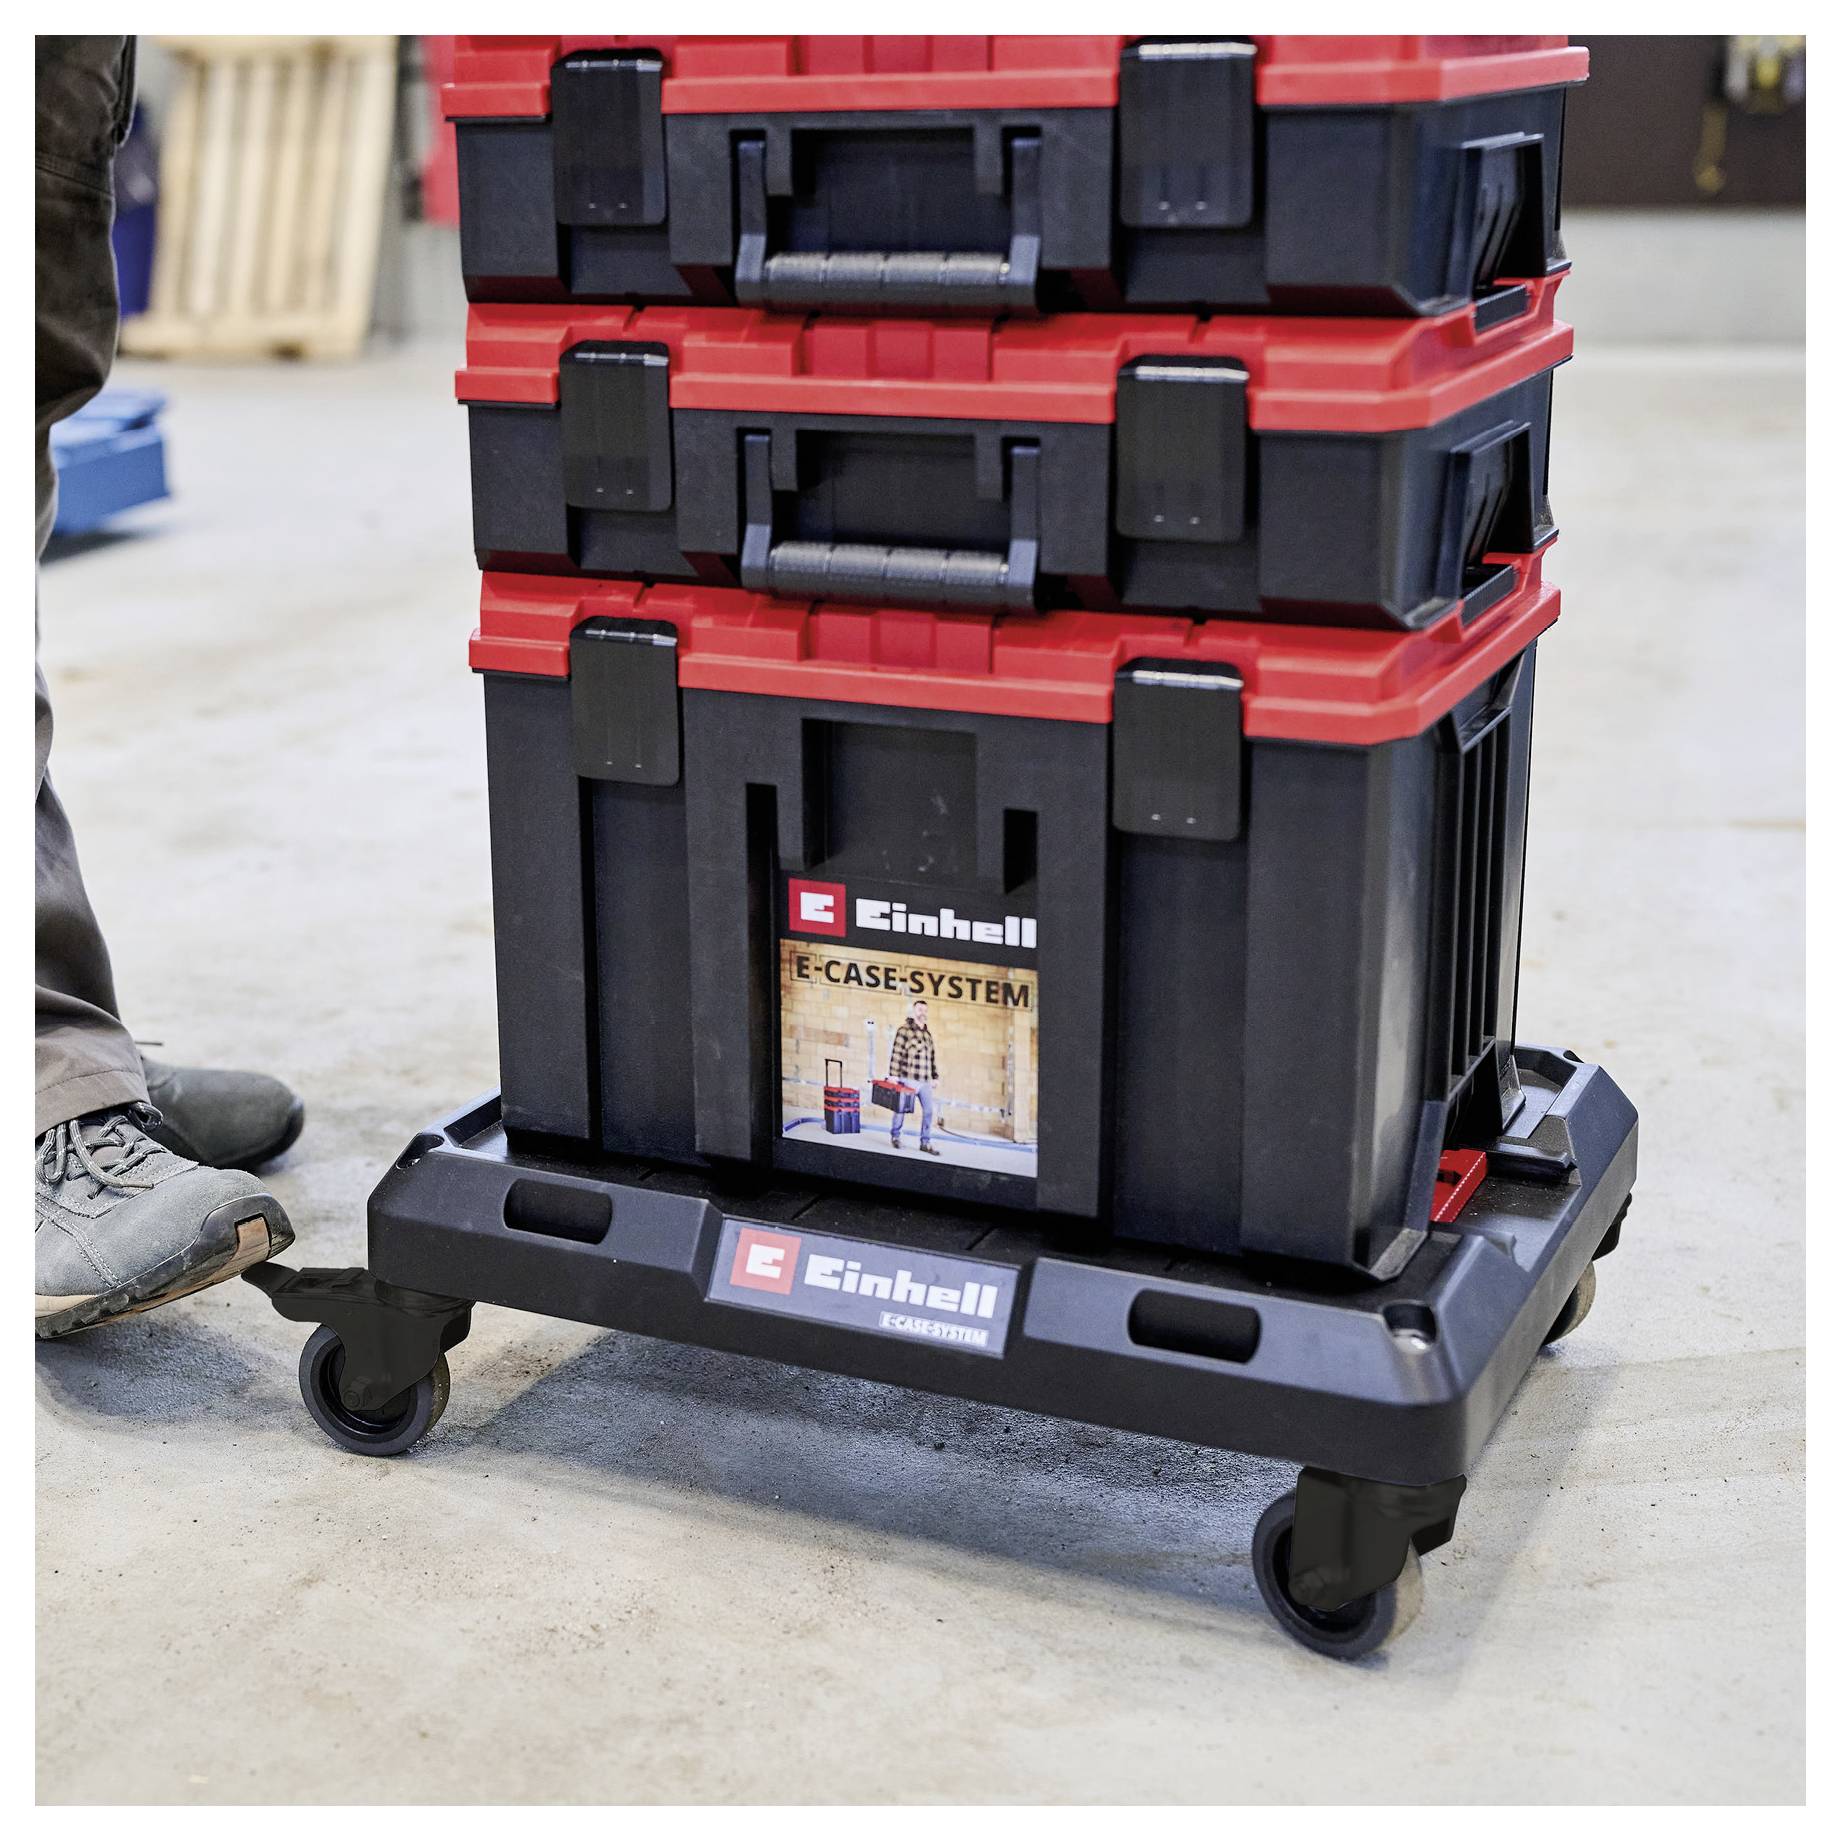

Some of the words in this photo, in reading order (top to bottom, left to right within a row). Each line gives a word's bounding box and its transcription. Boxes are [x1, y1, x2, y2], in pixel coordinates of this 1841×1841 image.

[855, 898, 1037, 948] Einhell
[796, 956, 1029, 1007] E-CASE-SYSTEM
[803, 1254, 998, 1319] Einhell
